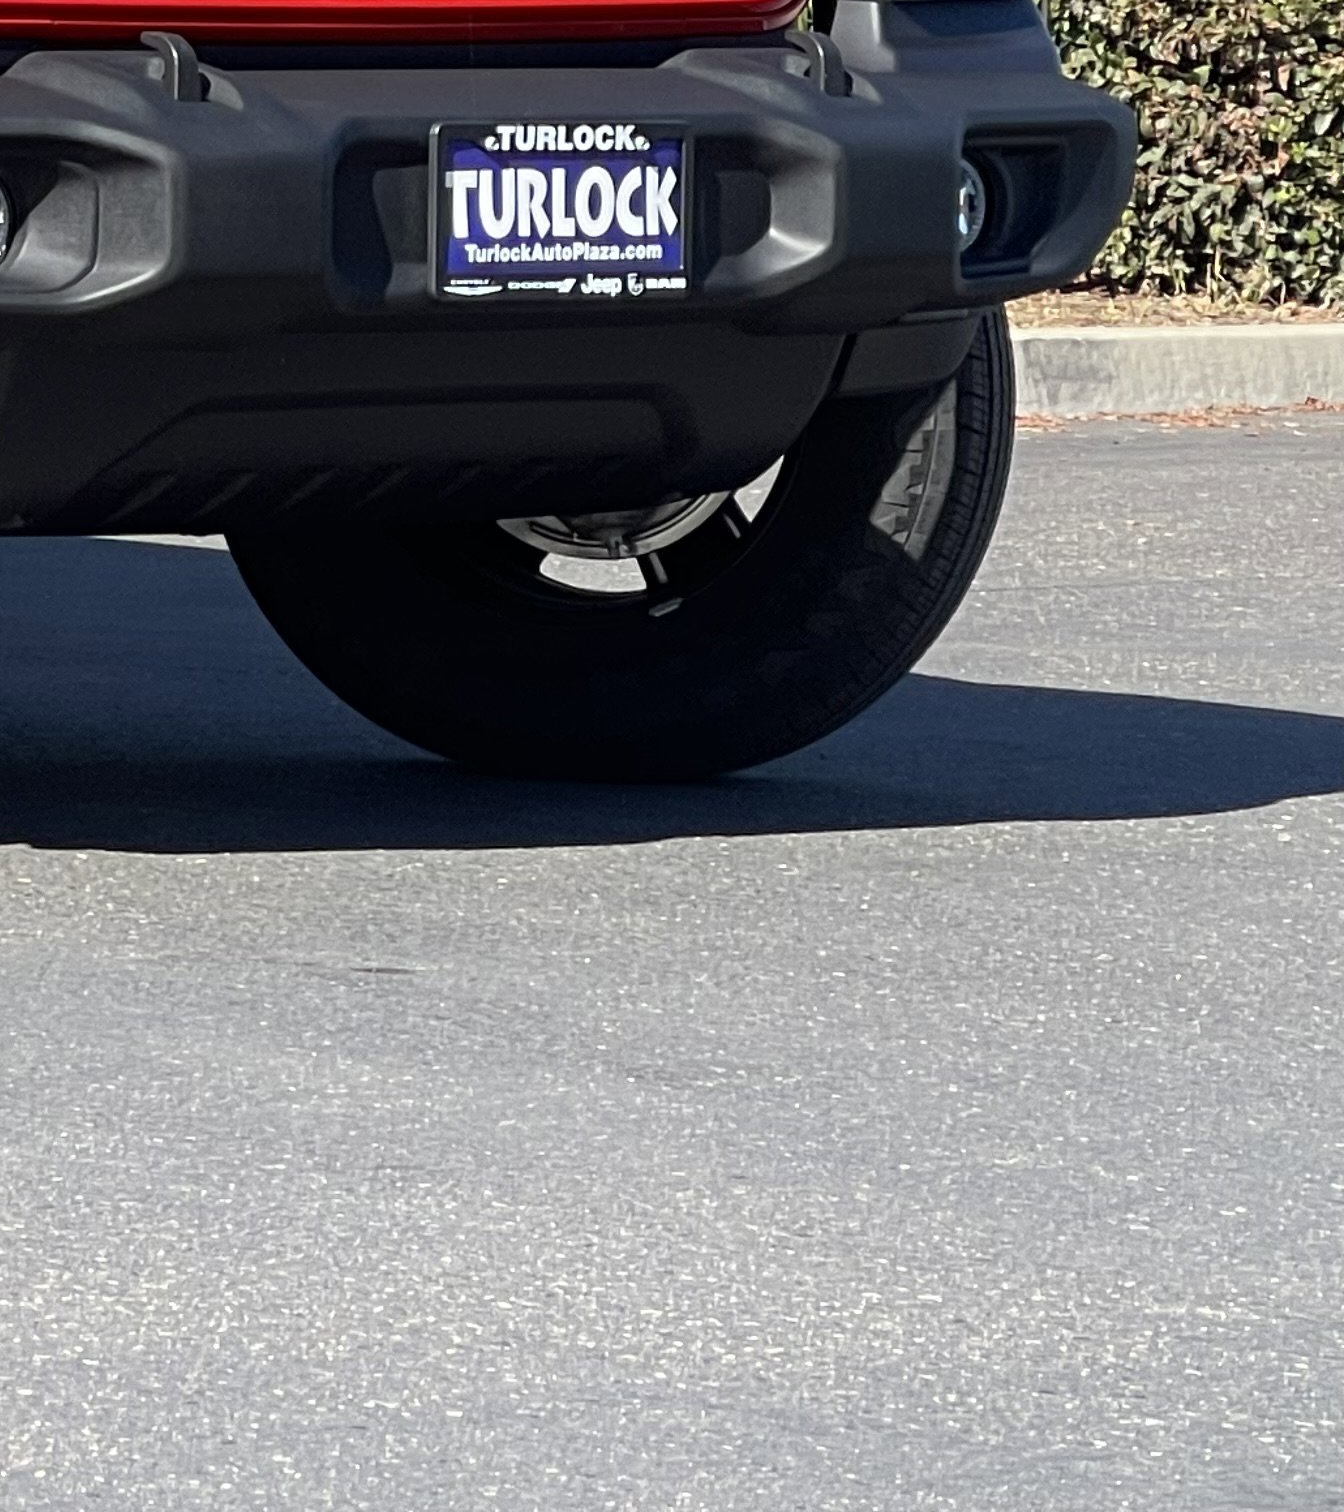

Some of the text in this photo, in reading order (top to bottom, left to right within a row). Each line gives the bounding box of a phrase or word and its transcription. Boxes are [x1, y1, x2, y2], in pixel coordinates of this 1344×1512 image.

[496, 124, 636, 152] TURLOCK
[445, 165, 679, 240] TURLOCK
[464, 243, 663, 263] TurlockAutoPlaza.com
[580, 273, 623, 298] Jeep
